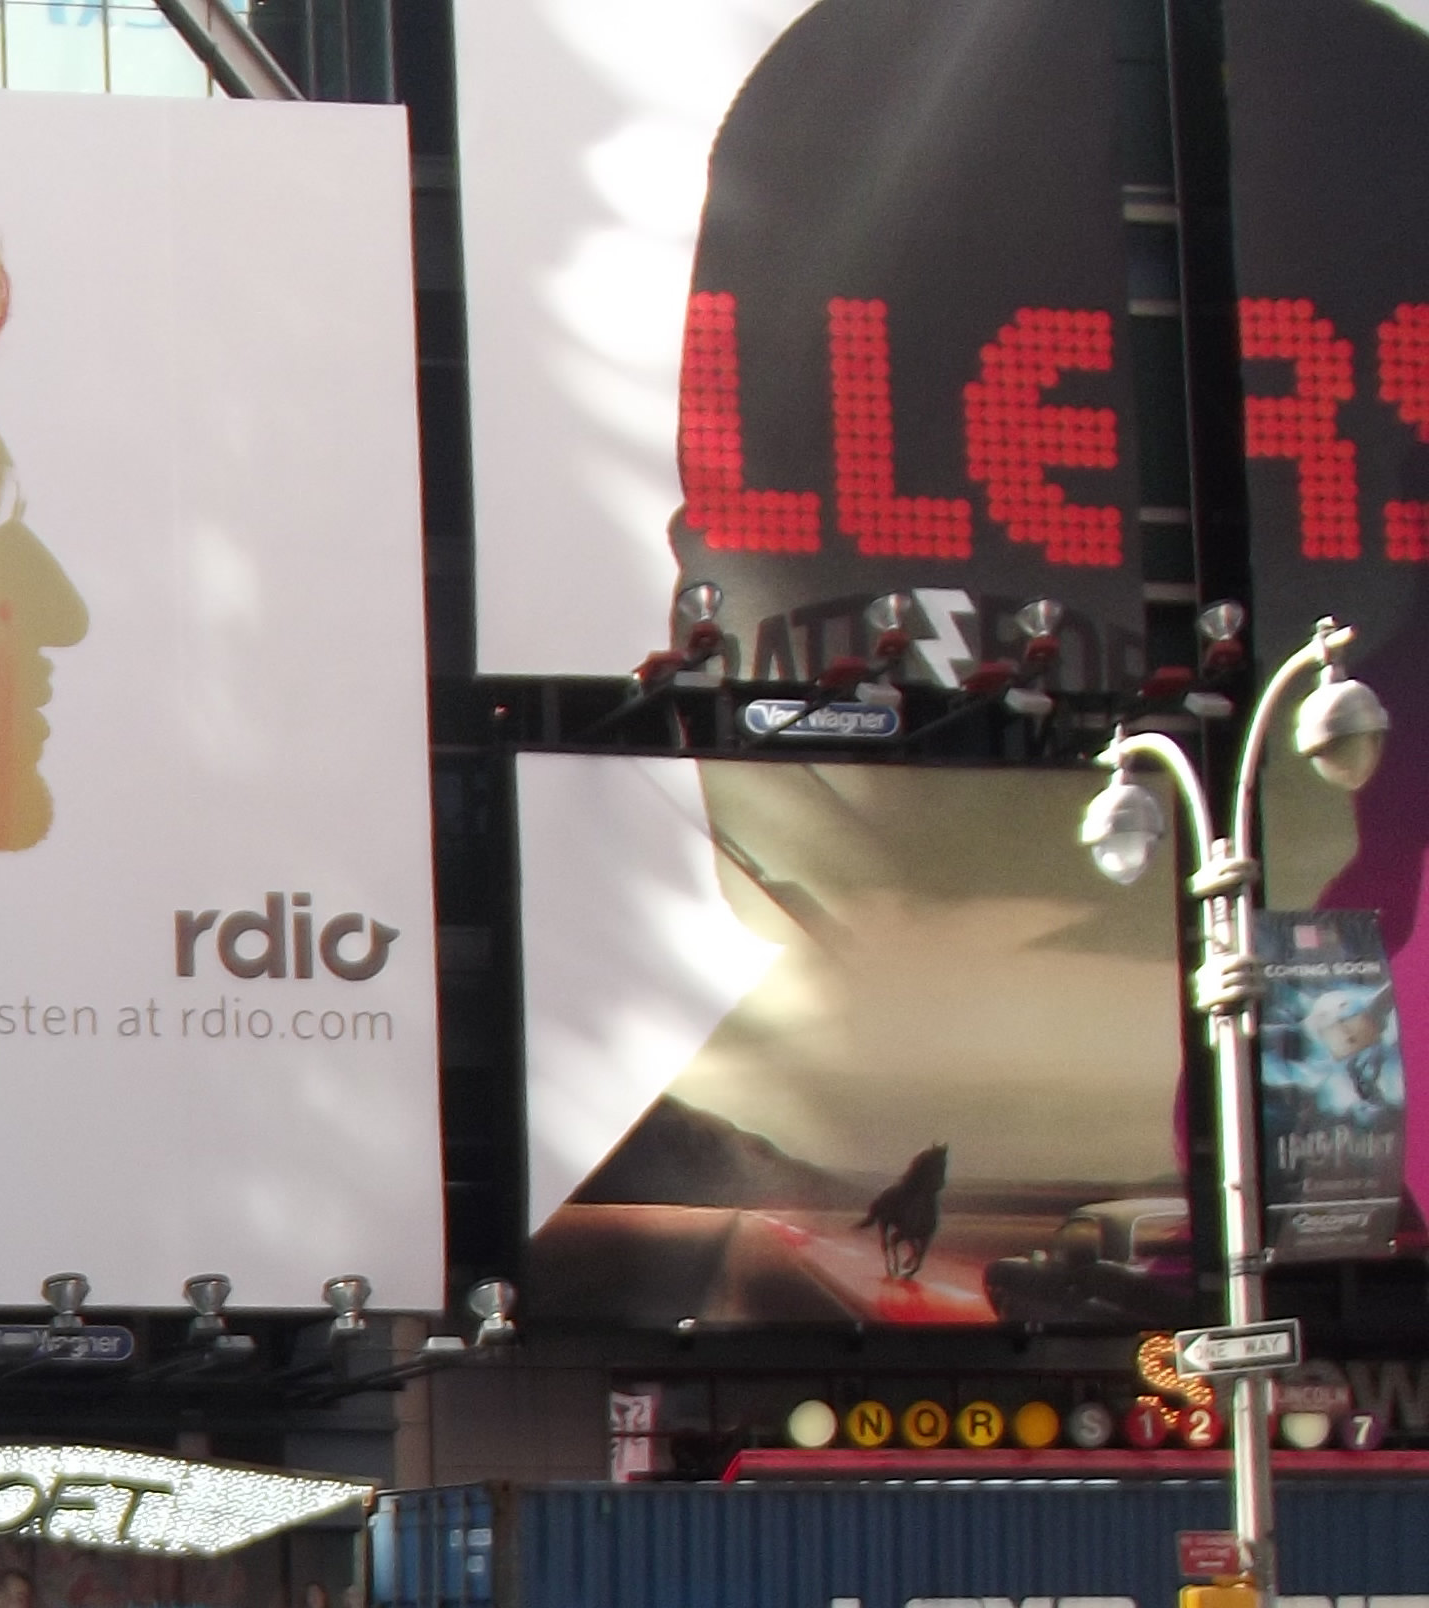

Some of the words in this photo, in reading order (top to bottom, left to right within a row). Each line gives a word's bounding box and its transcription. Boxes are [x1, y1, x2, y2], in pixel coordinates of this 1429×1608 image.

[174, 890, 401, 982] rdio
[1263, 963, 1330, 979] COMING
[1331, 961, 1381, 976] SOON
[116, 997, 161, 1037] at
[181, 994, 394, 1041] rdio.com
[1195, 1340, 1226, 1360] ONE
[1243, 1333, 1283, 1355] WAY
[859, 1410, 885, 1438] N
[968, 1410, 994, 1438] R
[1188, 1409, 1212, 1442] 2
[1352, 1415, 1374, 1446] 7
